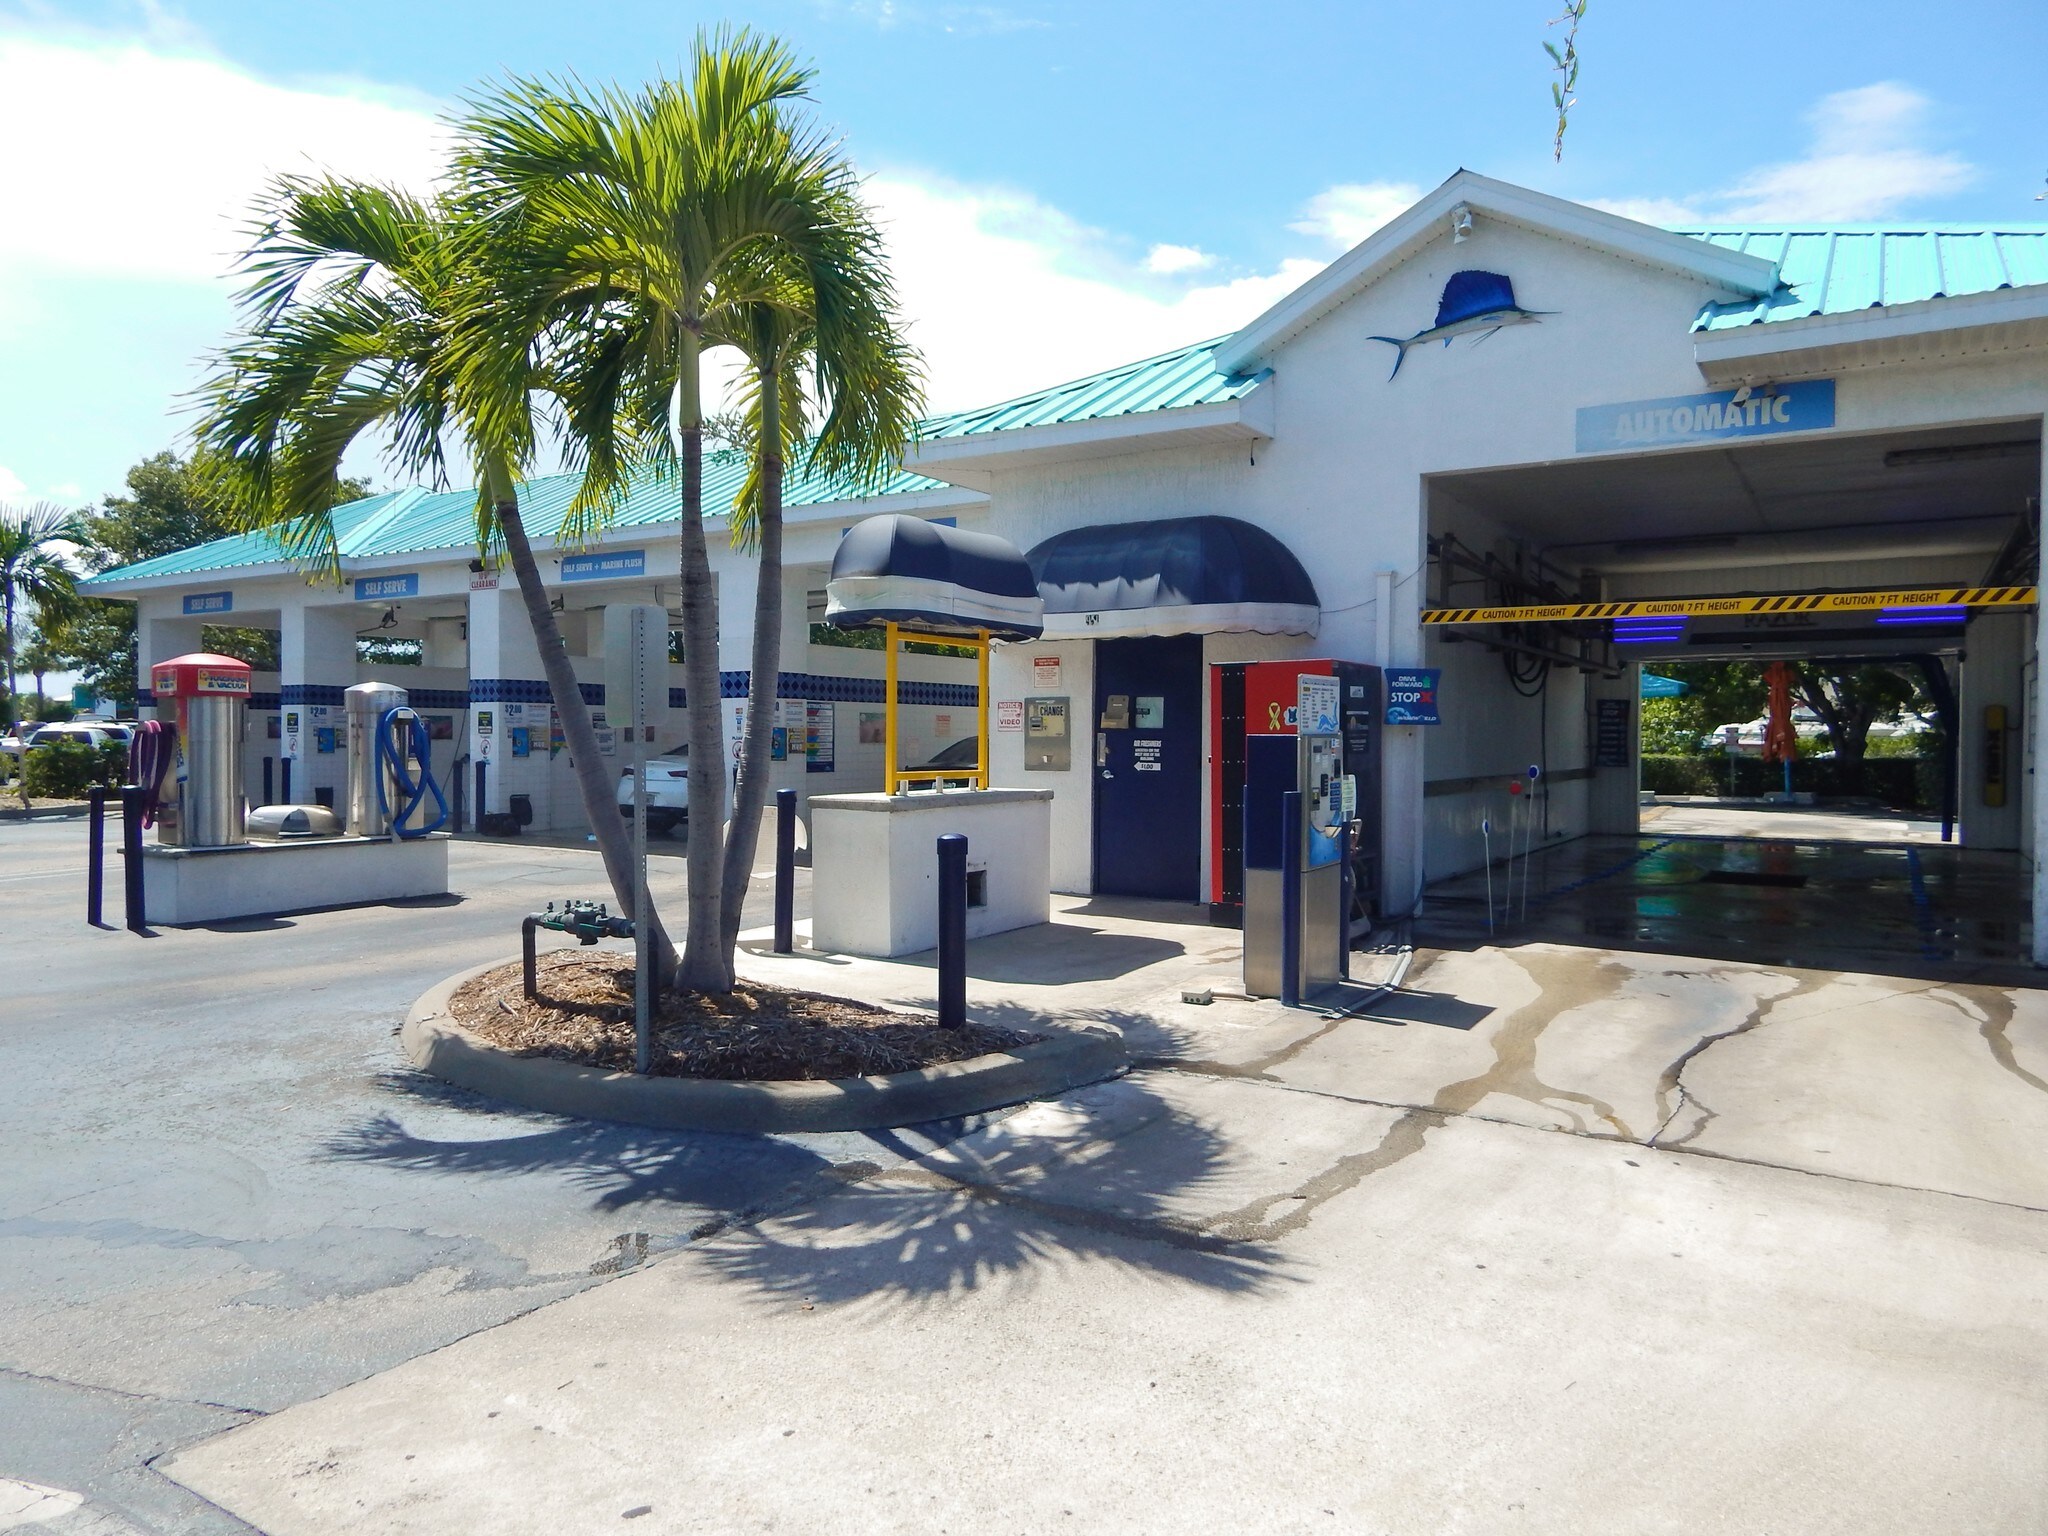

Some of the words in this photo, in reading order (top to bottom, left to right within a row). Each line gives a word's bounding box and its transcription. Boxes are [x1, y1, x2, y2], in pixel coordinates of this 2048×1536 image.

[1614, 395, 1791, 440] AUTOMATIC
[563, 564, 575, 574] SELF
[575, 562, 593, 573] SERVE
[601, 560, 624, 570] MARINE
[625, 558, 643, 568] FLUSH
[364, 581, 382, 596] SELF
[383, 579, 407, 594] SERVE
[190, 598, 205, 610] SELF
[205, 597, 224, 609] SERVE
[1832, 595, 1876, 606] CAUTION
[1879, 594, 1885, 604] 7
[1886, 594, 1898, 604] FT
[1902, 592, 1940, 603] HEIGHT
[1482, 609, 1517, 619] CAUTION
[1518, 609, 1524, 618] 7
[1524, 609, 1534, 618] FT
[1536, 607, 1567, 618] HEIGHT
[1645, 602, 1684, 613] CAUTION
[1687, 602, 1692, 611] 7
[1693, 602, 1704, 611] FT
[1707, 600, 1741, 611] HEIGHT
[1390, 692, 1420, 702] STOP
[504, 704, 522, 716] $2.00
[1040, 706, 1064, 716] CHANGE
